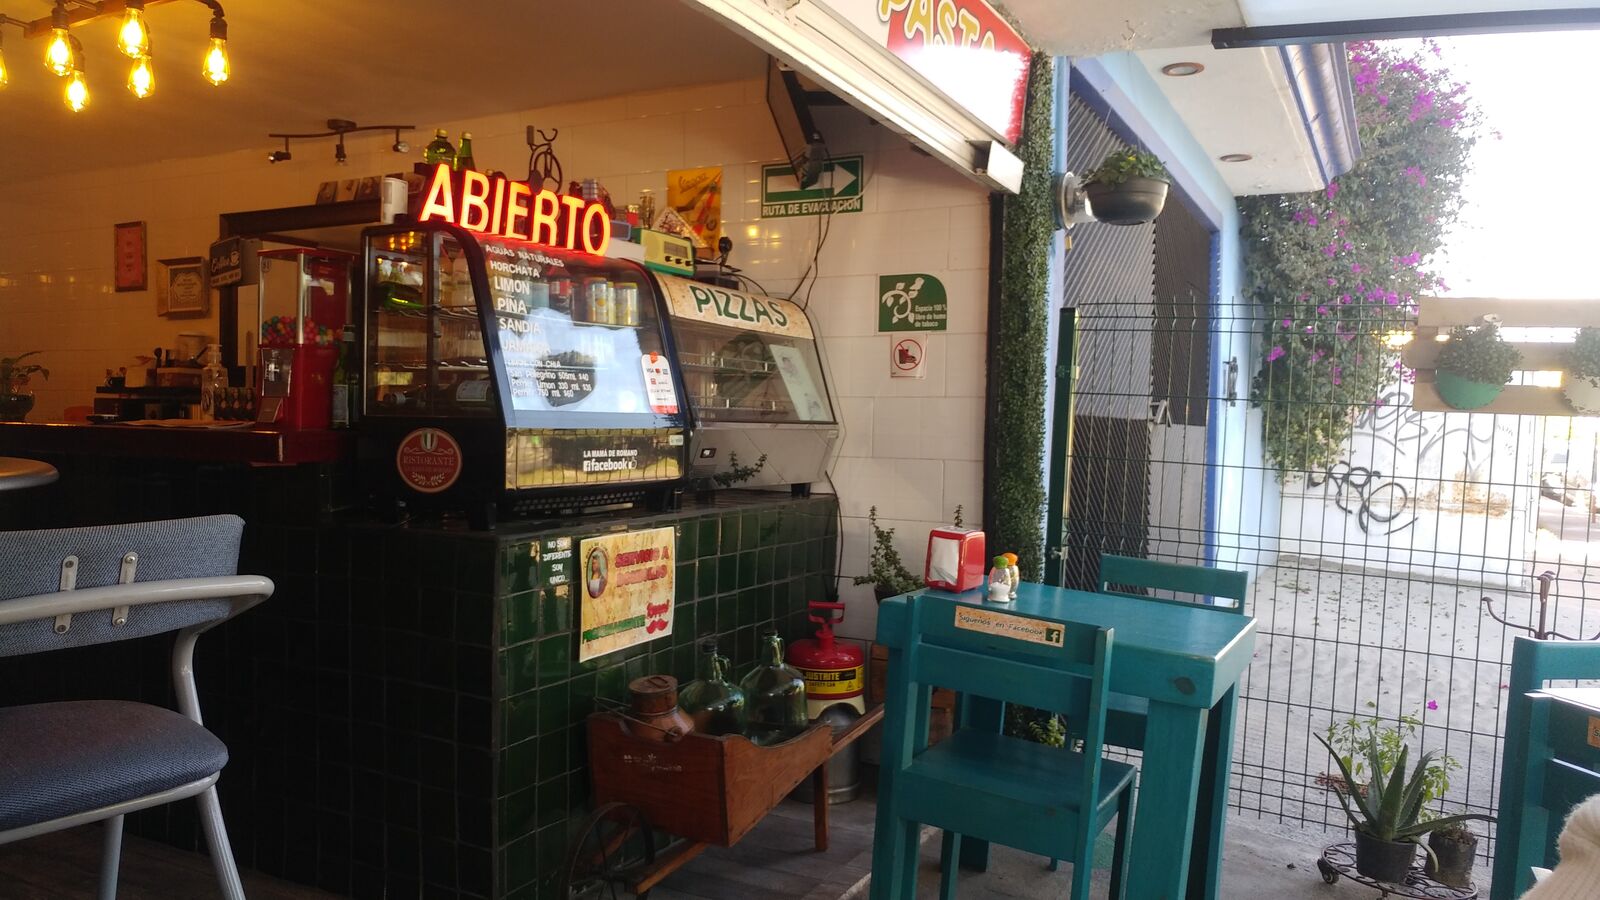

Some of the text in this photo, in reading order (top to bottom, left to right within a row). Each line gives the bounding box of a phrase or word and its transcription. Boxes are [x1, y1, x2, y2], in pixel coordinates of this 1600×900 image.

[418, 162, 612, 258] ABIERTO
[762, 204, 786, 216] RUTA
[787, 203, 800, 214] DE
[486, 244, 564, 268] AGUAS NATURALES
[489, 260, 540, 278] HORCHATA
[494, 276, 530, 295] LIMON
[497, 294, 528, 314] PIÑA
[688, 285, 788, 328] PIZZAS
[499, 318, 541, 334] SANDIA
[583, 450, 592, 458] LA
[608, 449, 616, 457] DE
[616, 449, 638, 457] ROMANO
[591, 458, 628, 472] facebook
[547, 540, 557, 549] NO
[660, 546, 670, 561] A
[551, 563, 564, 573] SOY
[995, 621, 1005, 629] en
[1007, 623, 1044, 636] Facebook
